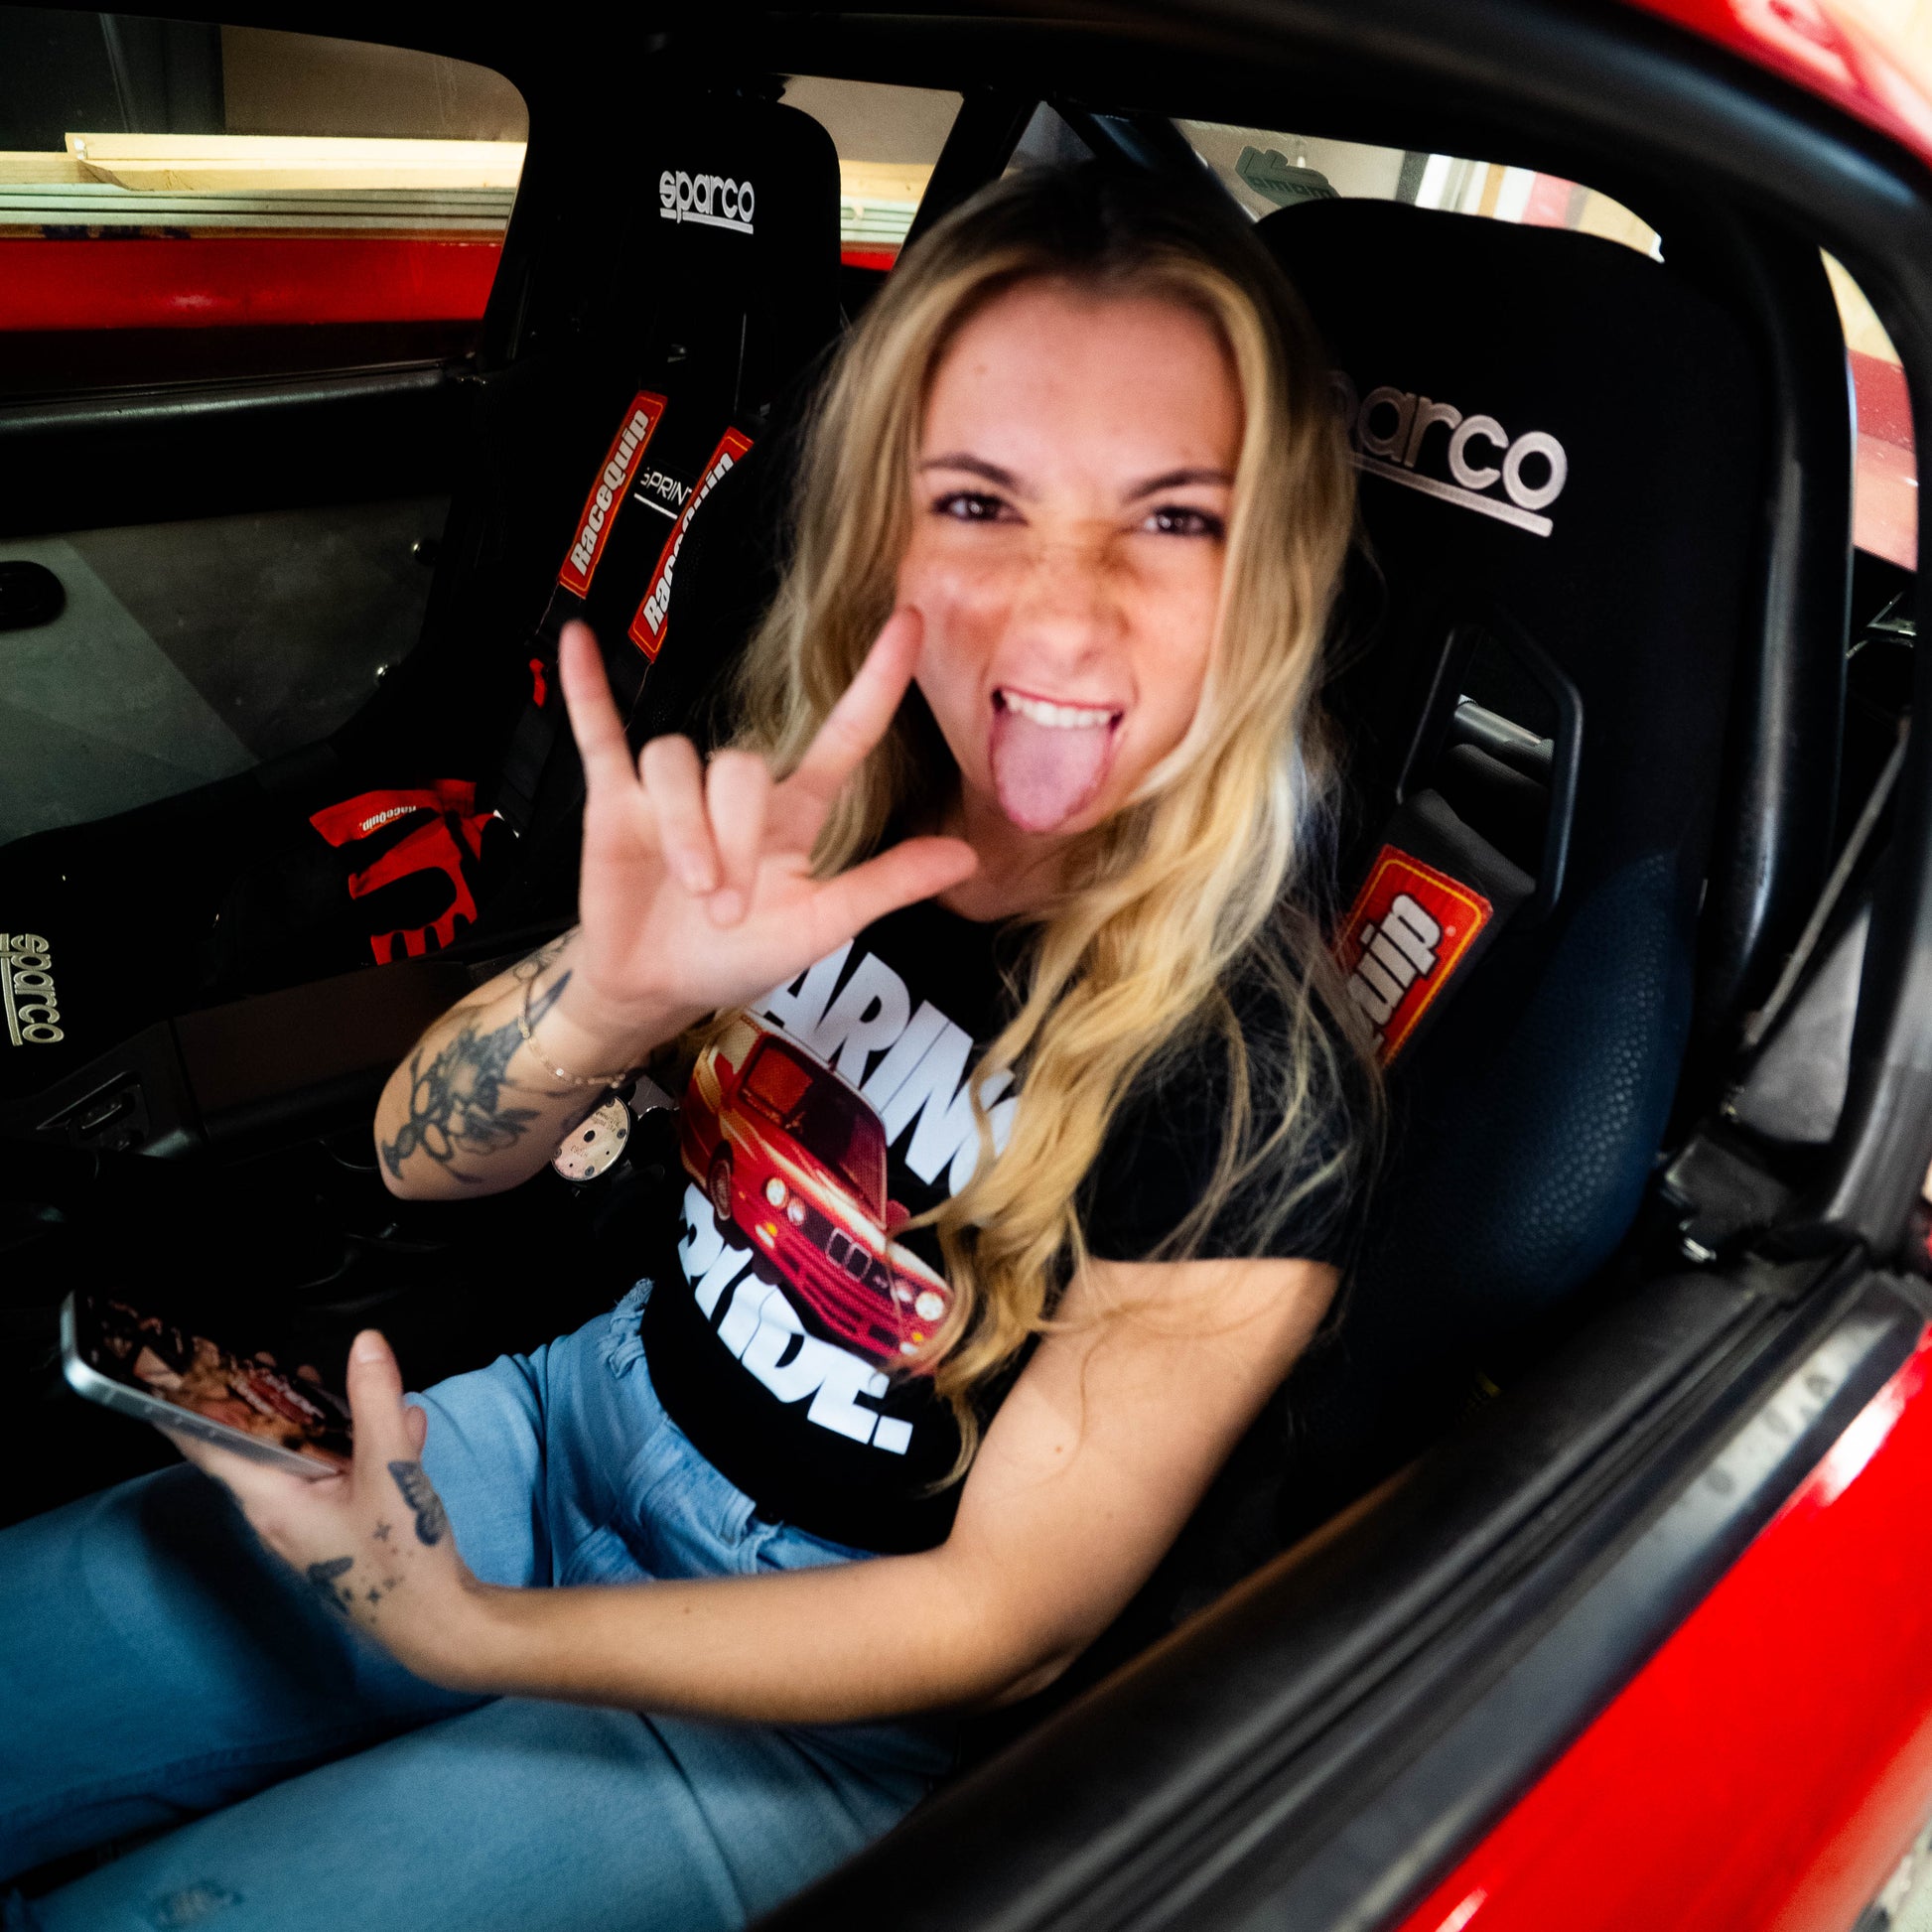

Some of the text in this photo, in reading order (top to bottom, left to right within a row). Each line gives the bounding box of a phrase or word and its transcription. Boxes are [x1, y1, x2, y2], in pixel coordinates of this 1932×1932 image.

[659, 170, 755, 226] sparco
[570, 409, 649, 576] RaceQuip
[639, 467, 693, 506] SPRIN
[0, 933, 65, 1045] sparco
[1346, 894, 1442, 1049] uip
